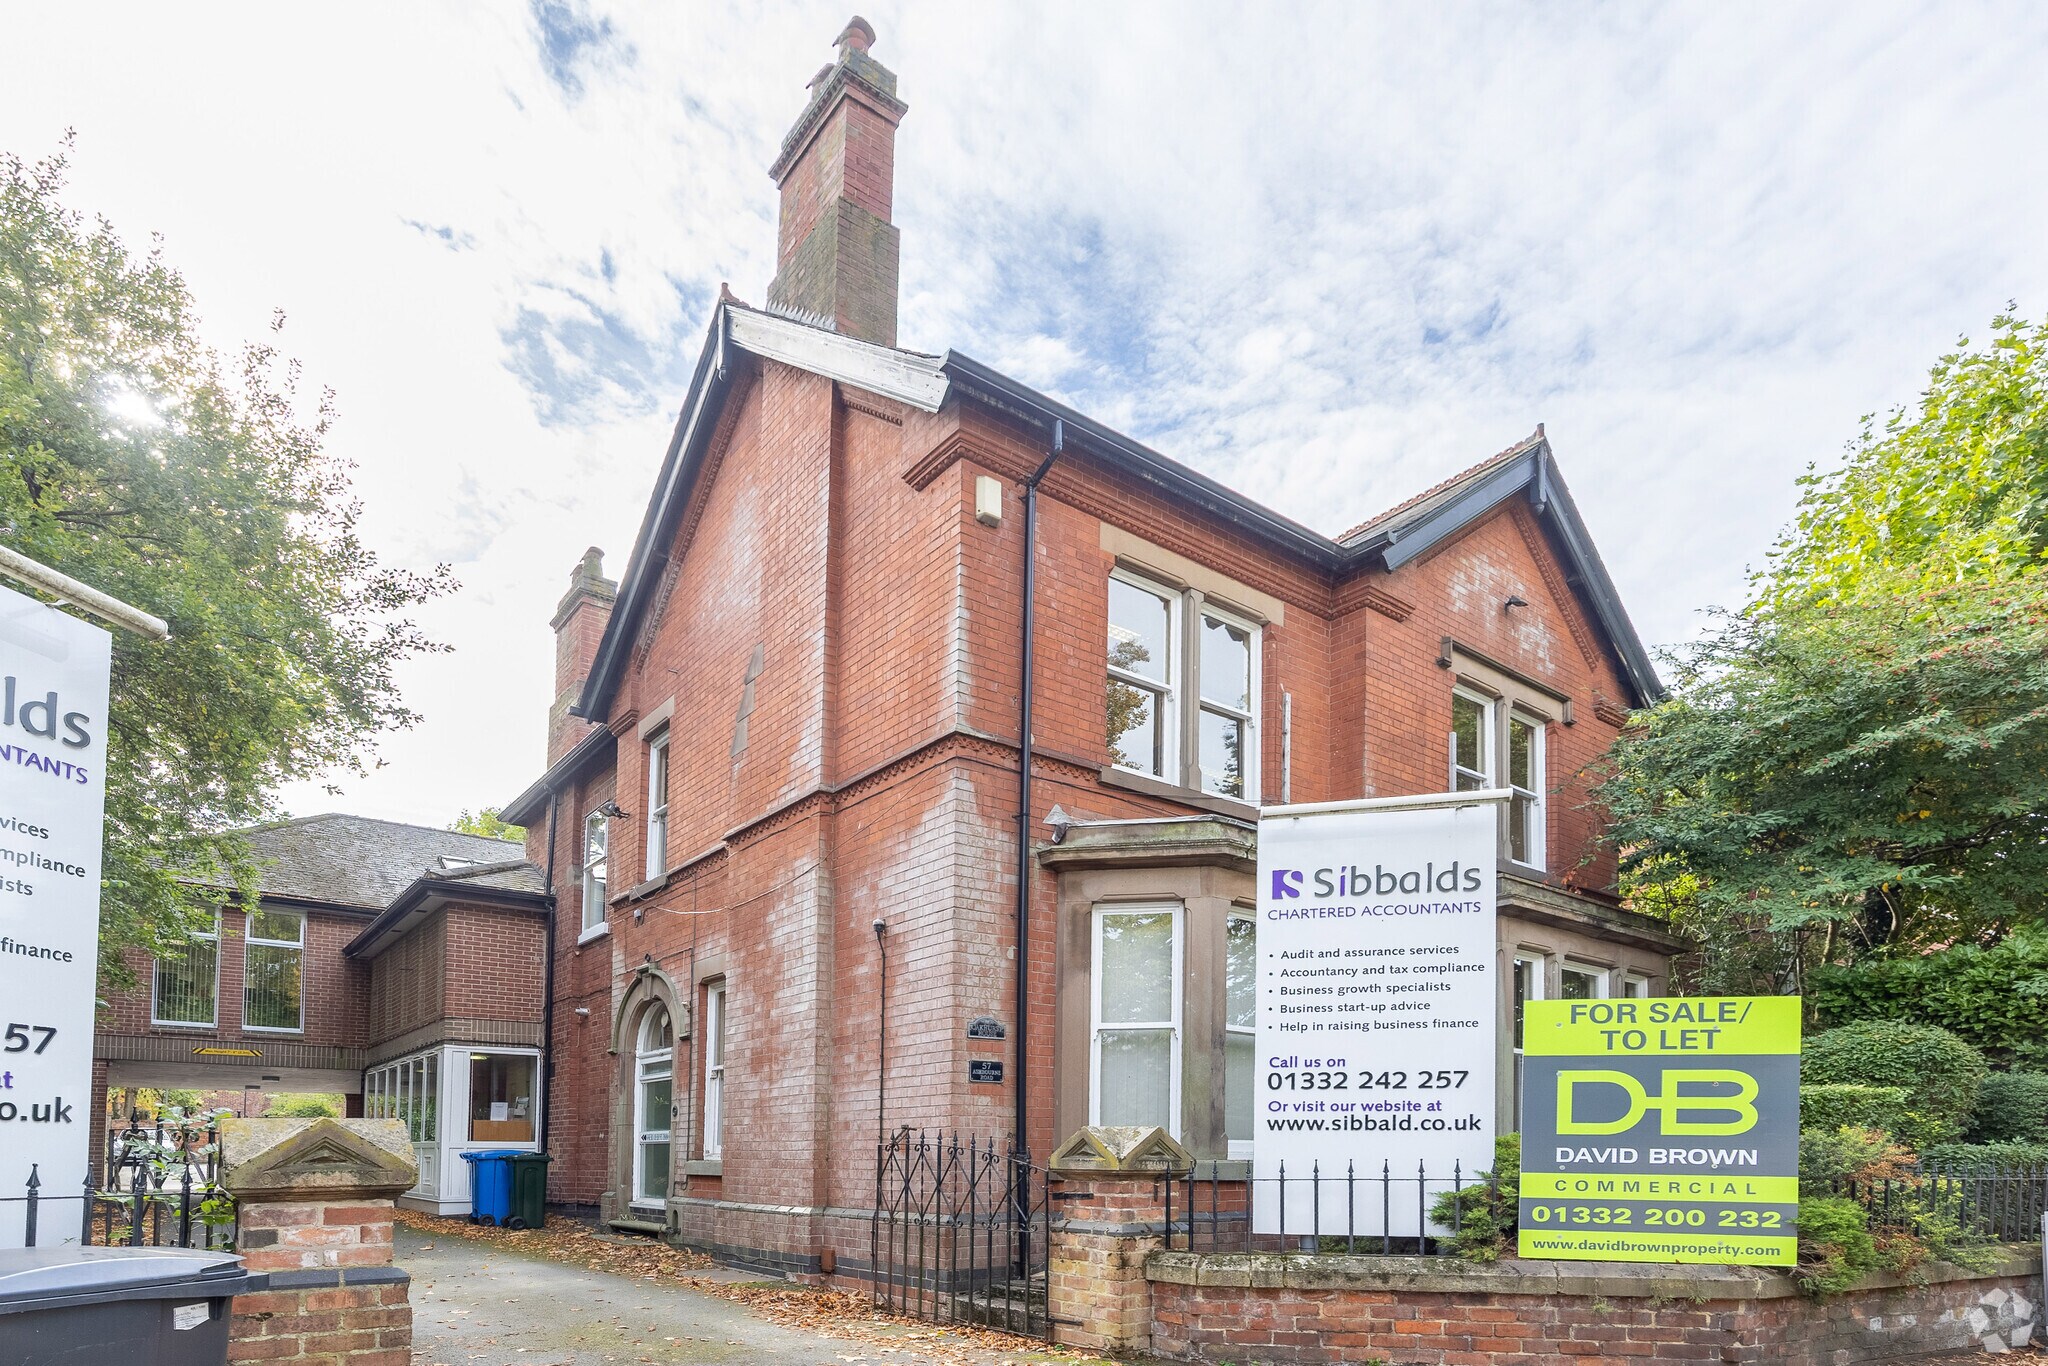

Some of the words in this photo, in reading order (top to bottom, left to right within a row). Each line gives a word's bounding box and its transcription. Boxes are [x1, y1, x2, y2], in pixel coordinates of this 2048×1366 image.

[1314, 861, 1481, 898] Sibbalds
[1268, 906, 1356, 920] CHARTERED
[1361, 902, 1481, 917] ACCOUNTANTS
[0, 937, 73, 963] finance
[1281, 950, 1313, 960] Audit
[1318, 948, 1340, 958] and
[1345, 948, 1405, 957] assurance
[1410, 945, 1459, 955] services
[1280, 967, 1358, 978] Accountancy
[1362, 965, 1384, 975] and
[1390, 965, 1408, 974] tax
[1413, 963, 1485, 975] compliance
[1280, 986, 1333, 995] Business
[1338, 984, 1381, 996] growth
[1386, 982, 1451, 994] specialists
[1280, 1004, 1333, 1013] Business
[1338, 1003, 1386, 1013] start-up
[1391, 1001, 1430, 1011] advice
[1571, 1004, 1637, 1024] FOR
[1649, 1002, 1752, 1024] SALE/
[1280, 1022, 1308, 1033] Help
[1313, 1022, 1323, 1030] in
[1328, 1022, 1369, 1032] raising
[1374, 1020, 1428, 1030] business
[1433, 1019, 1479, 1028] finance
[4, 1023, 58, 1055] 57
[1600, 1030, 1646, 1050] TO
[1660, 1029, 1721, 1050] LET
[982, 1062, 992, 1070] 57
[1269, 1056, 1298, 1068] Call
[1304, 1058, 1321, 1067] us
[1327, 1058, 1346, 1067] on
[1268, 1072, 1348, 1090] 01332
[1359, 1071, 1407, 1089] 242
[1418, 1070, 1469, 1089] 257
[1268, 1101, 1288, 1112] Or
[1293, 1101, 1325, 1112] visit
[1330, 1103, 1356, 1112] our
[1361, 1100, 1422, 1111] website
[1427, 1100, 1442, 1111] at
[1267, 1114, 1482, 1131] www.sibbald.co.uk
[1556, 1147, 1638, 1164] DAVID
[1649, 1149, 1758, 1166] BROWN
[1555, 1180, 1756, 1195] COMMERCIAL
[1532, 1206, 1632, 1224] 01332
[1645, 1208, 1706, 1226] 200
[1718, 1210, 1781, 1228] 232
[1533, 1238, 1780, 1257] www.davidbrownproperty.com
